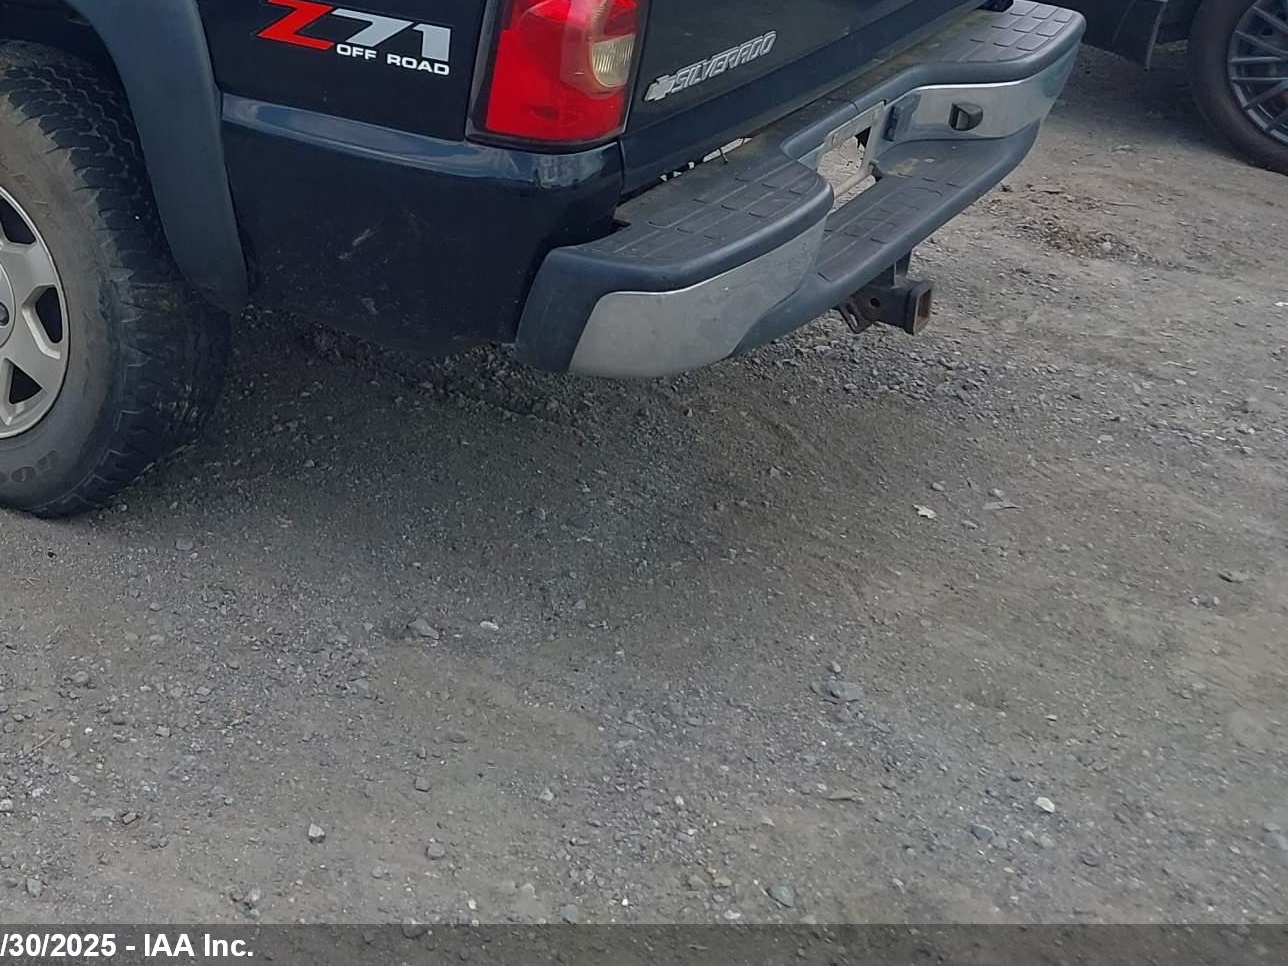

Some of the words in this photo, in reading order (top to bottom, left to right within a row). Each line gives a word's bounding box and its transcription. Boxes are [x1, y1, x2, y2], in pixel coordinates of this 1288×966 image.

[336, 43, 377, 60] OFF
[386, 53, 450, 76] ROAD
[671, 30, 777, 94] SILVERADO
